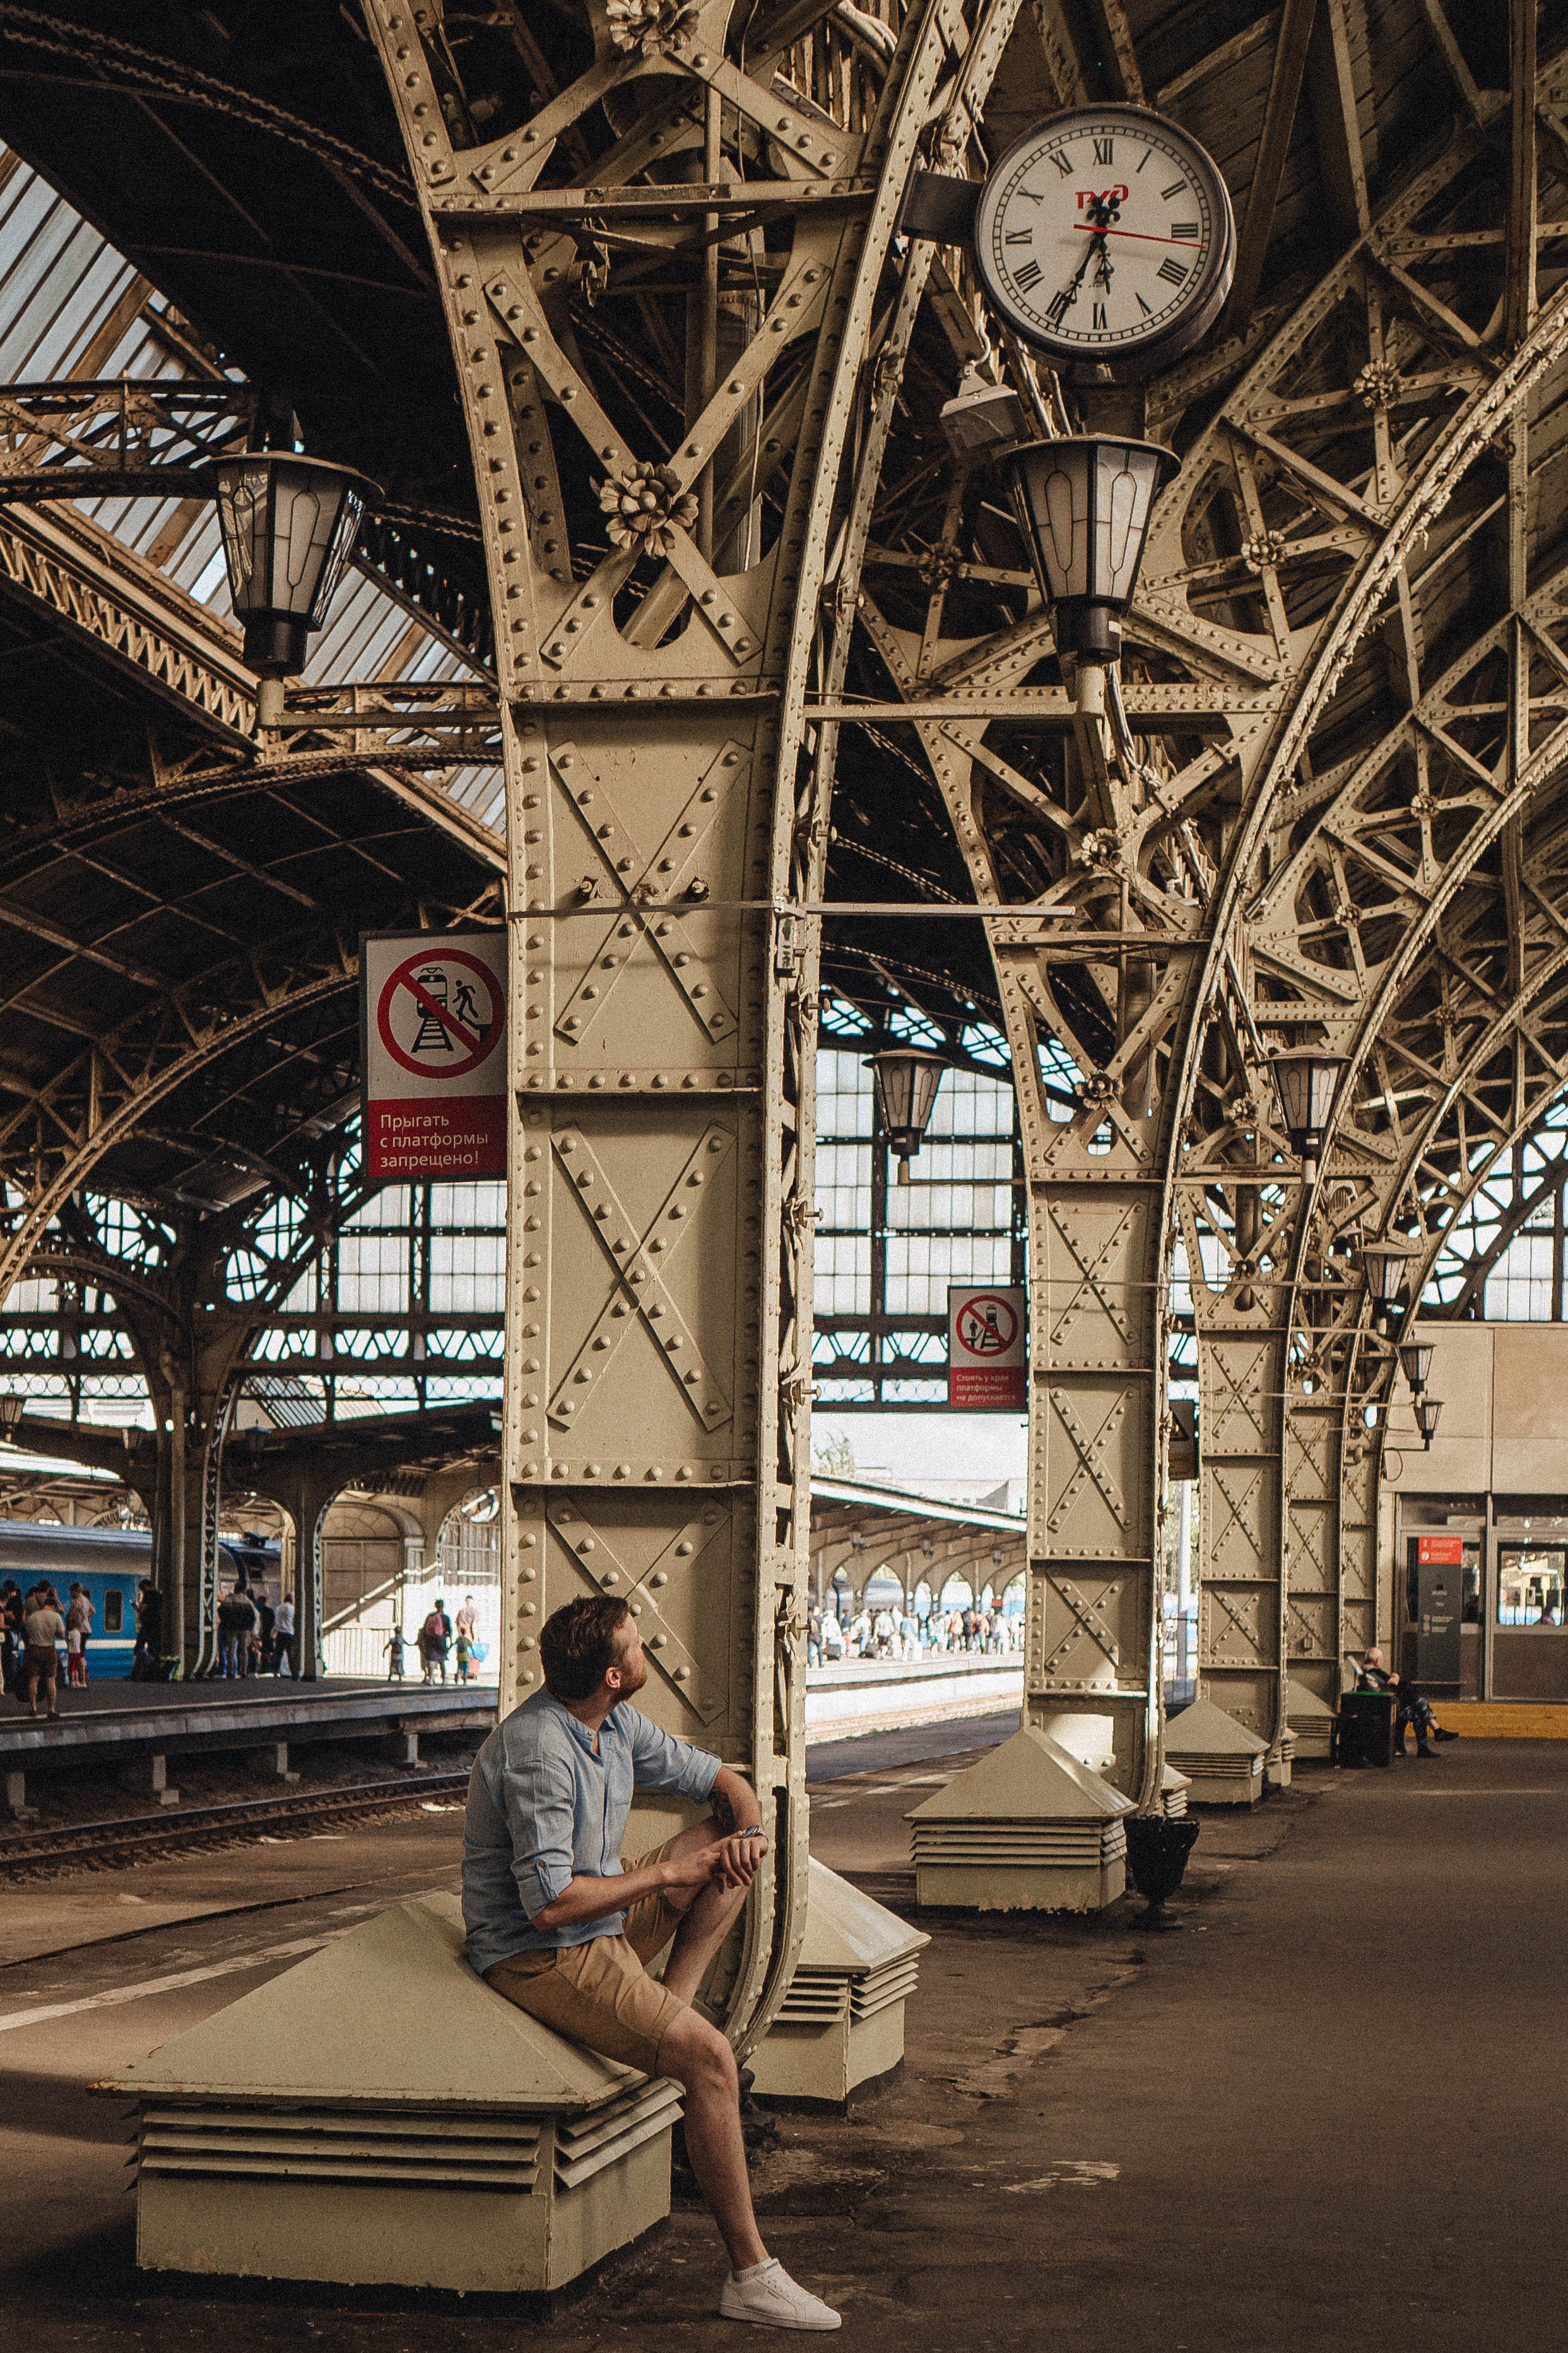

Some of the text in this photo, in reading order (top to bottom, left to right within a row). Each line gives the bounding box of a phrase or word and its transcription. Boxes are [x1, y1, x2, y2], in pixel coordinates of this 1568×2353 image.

[1093, 138, 1113, 165] XII
[1049, 149, 1074, 179] XI
[1017, 186, 1044, 206] X
[1171, 223, 1199, 239] III
[1135, 292, 1153, 317] V
[1092, 303, 1108, 329] VI
[381, 1115, 449, 1132] Прыгать
[380, 1132, 488, 1149] с платформы
[380, 1151, 478, 1170] запрещено!
